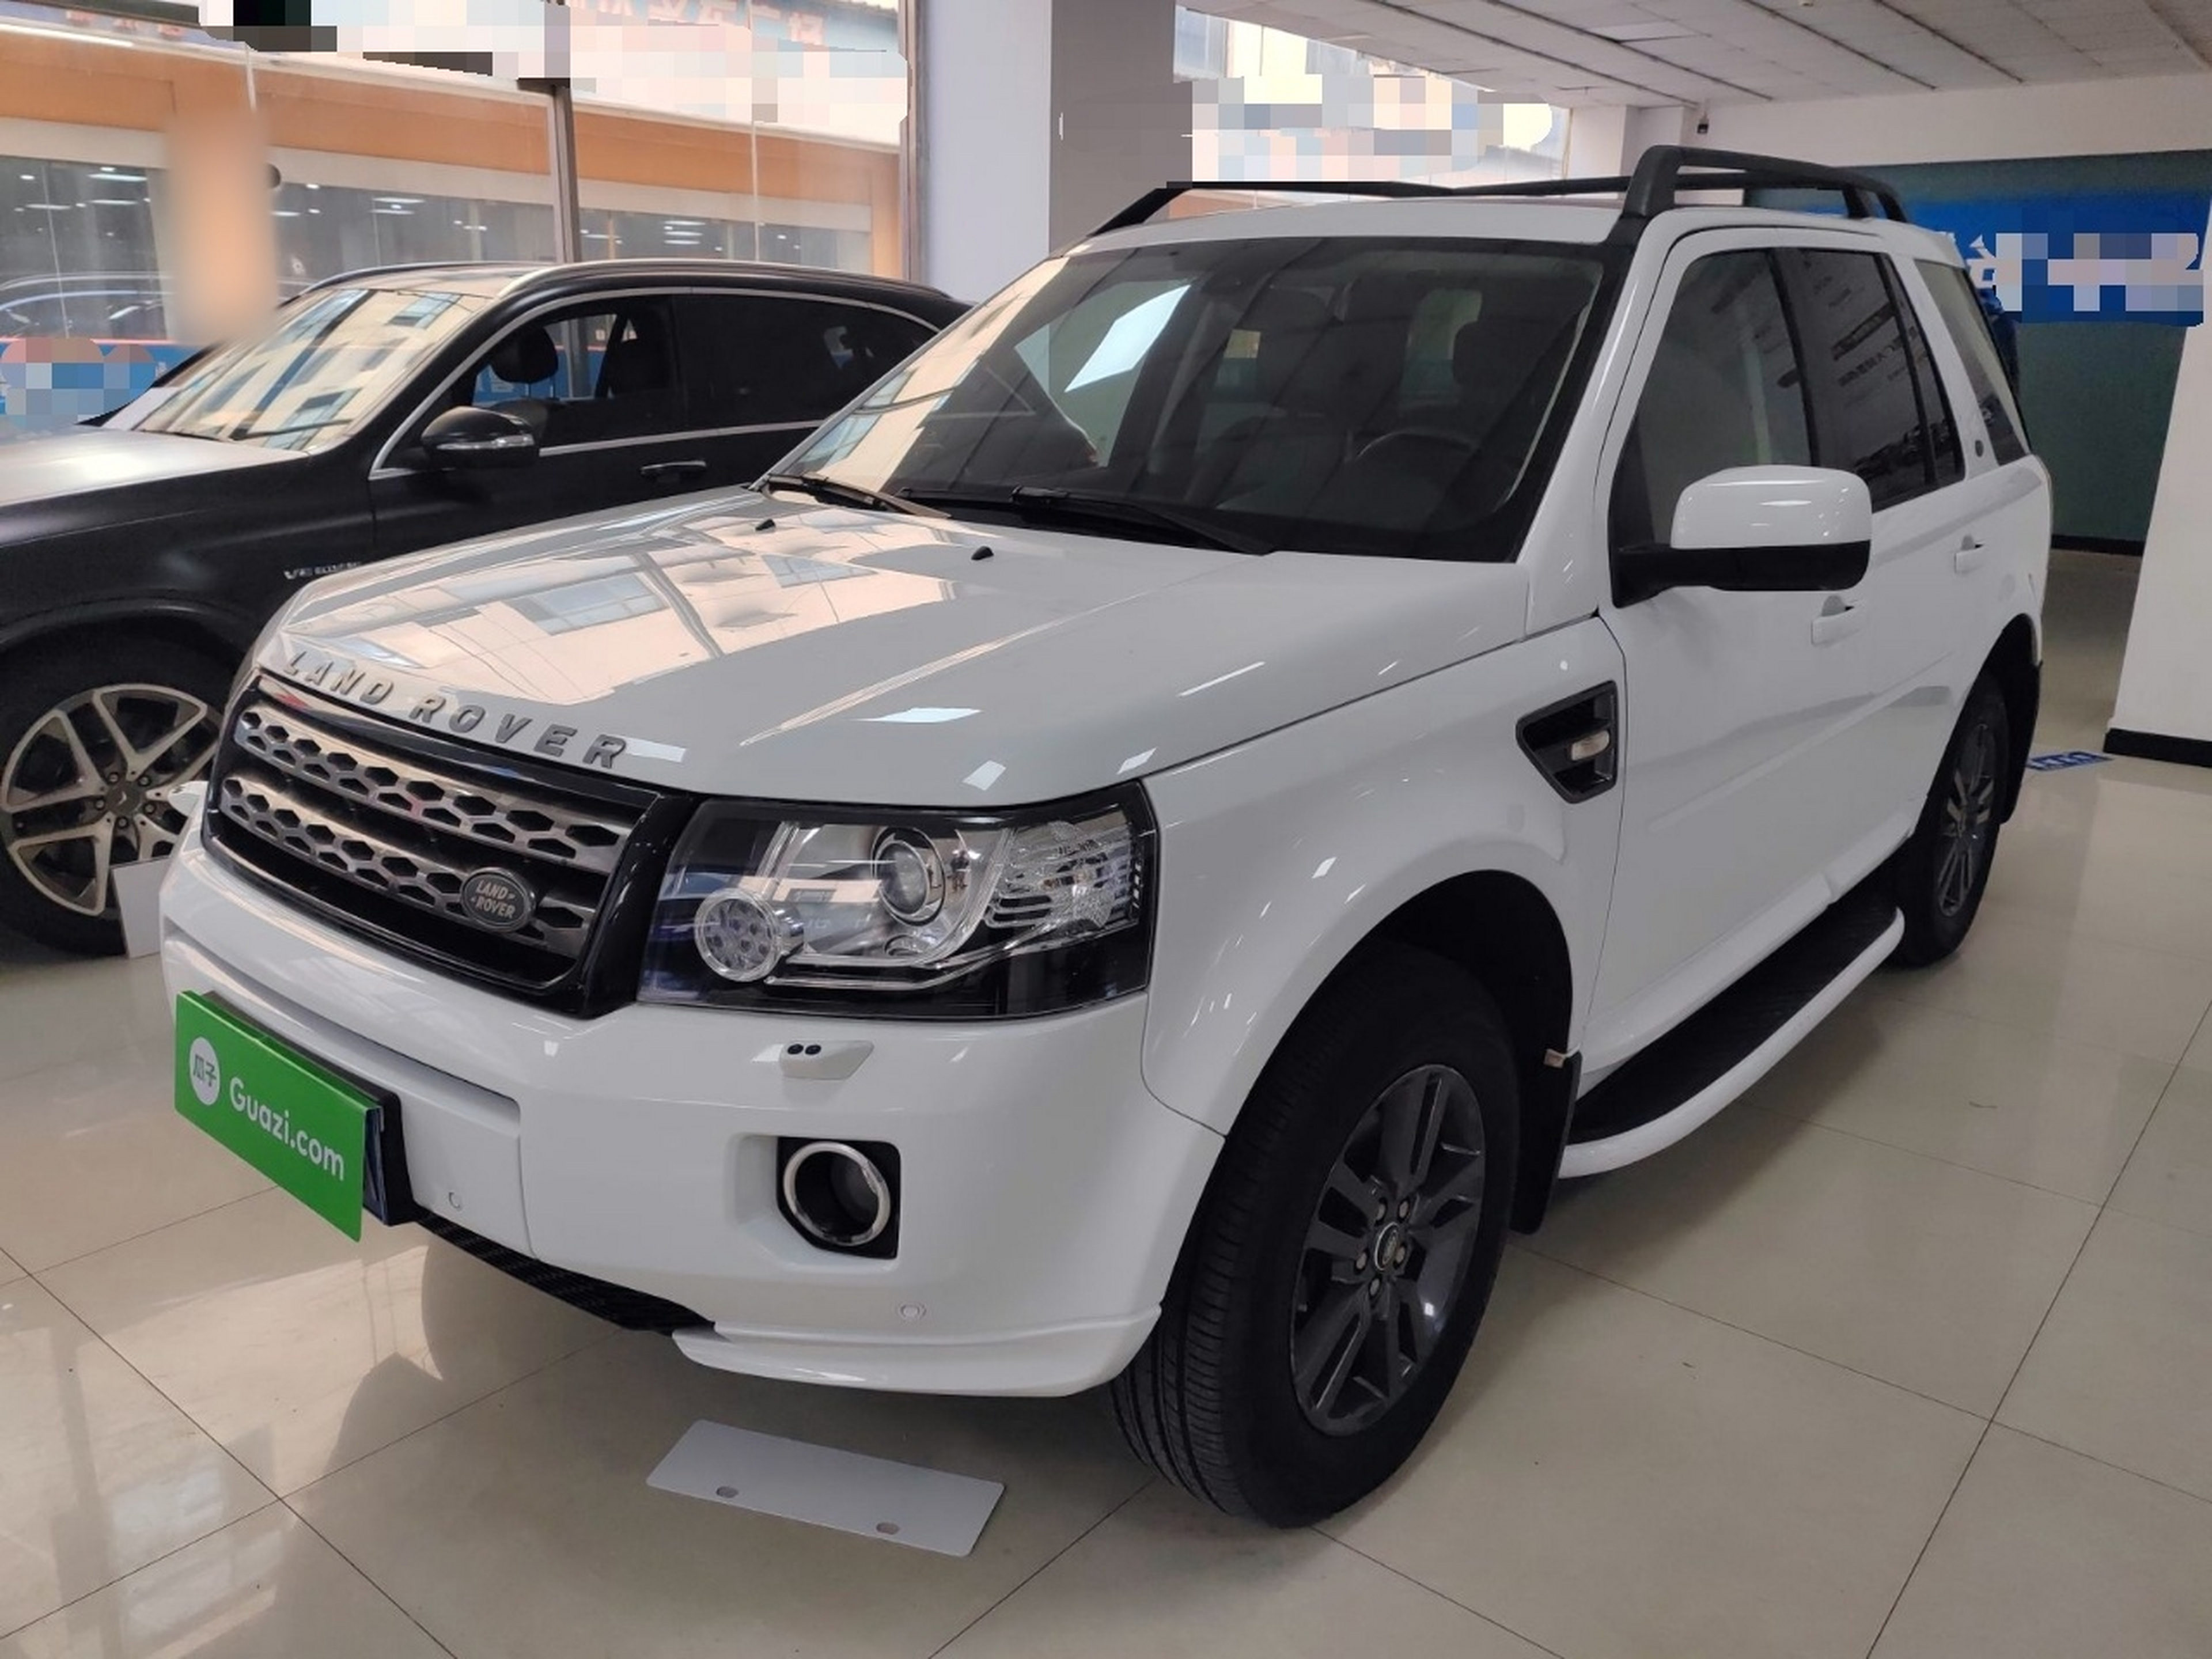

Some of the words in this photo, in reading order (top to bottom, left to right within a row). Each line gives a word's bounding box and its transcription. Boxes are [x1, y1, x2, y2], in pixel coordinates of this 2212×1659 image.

[283, 650, 394, 706] LAND
[408, 694, 627, 769] ROVER
[475, 895, 516, 919] ROVER
[230, 1076, 344, 1181] Guazi.com
